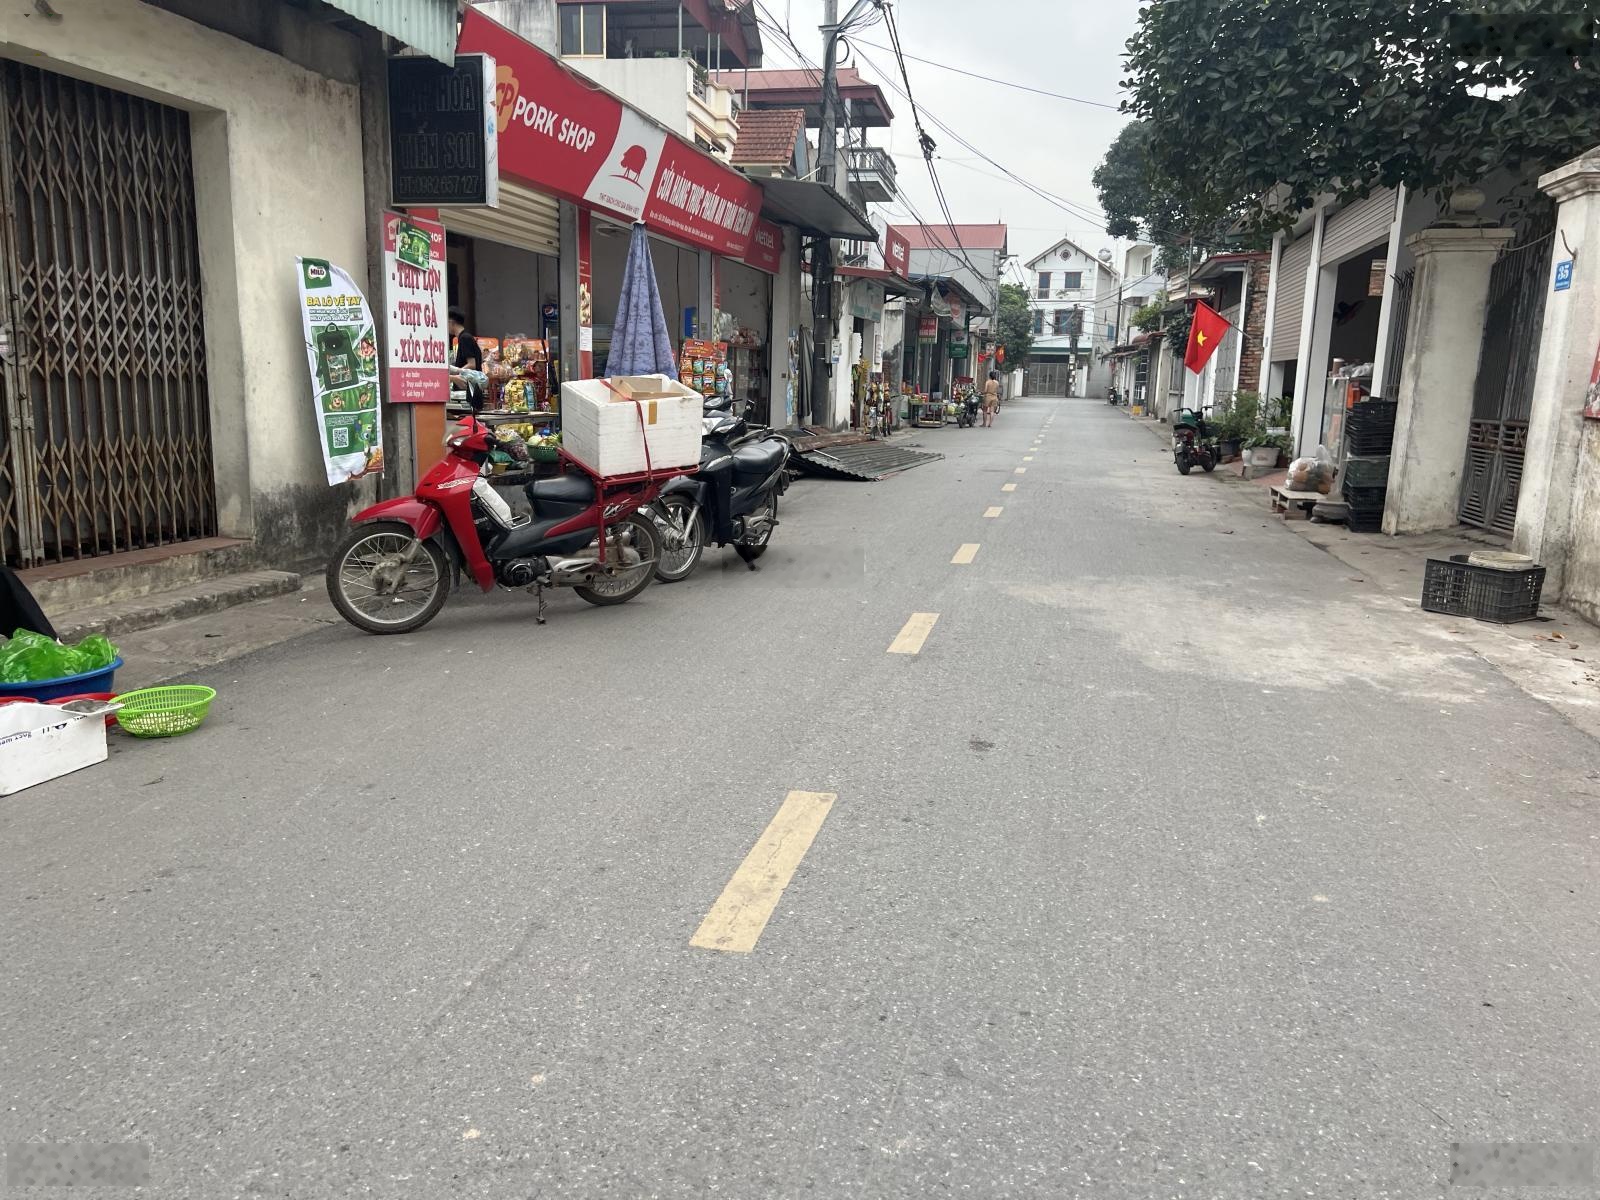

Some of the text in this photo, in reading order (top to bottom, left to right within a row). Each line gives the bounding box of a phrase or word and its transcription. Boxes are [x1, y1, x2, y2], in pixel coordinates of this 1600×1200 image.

[512, 95, 596, 153] PORK SHOP
[310, 268, 325, 276] MILO
[397, 264, 441, 298] THỊT LỢN
[306, 296, 321, 307] BA
[322, 295, 333, 306] LÔ
[346, 296, 362, 306] TAY
[398, 299, 438, 332] THỊT GÀ
[400, 333, 446, 364] XÚC XÍCH
